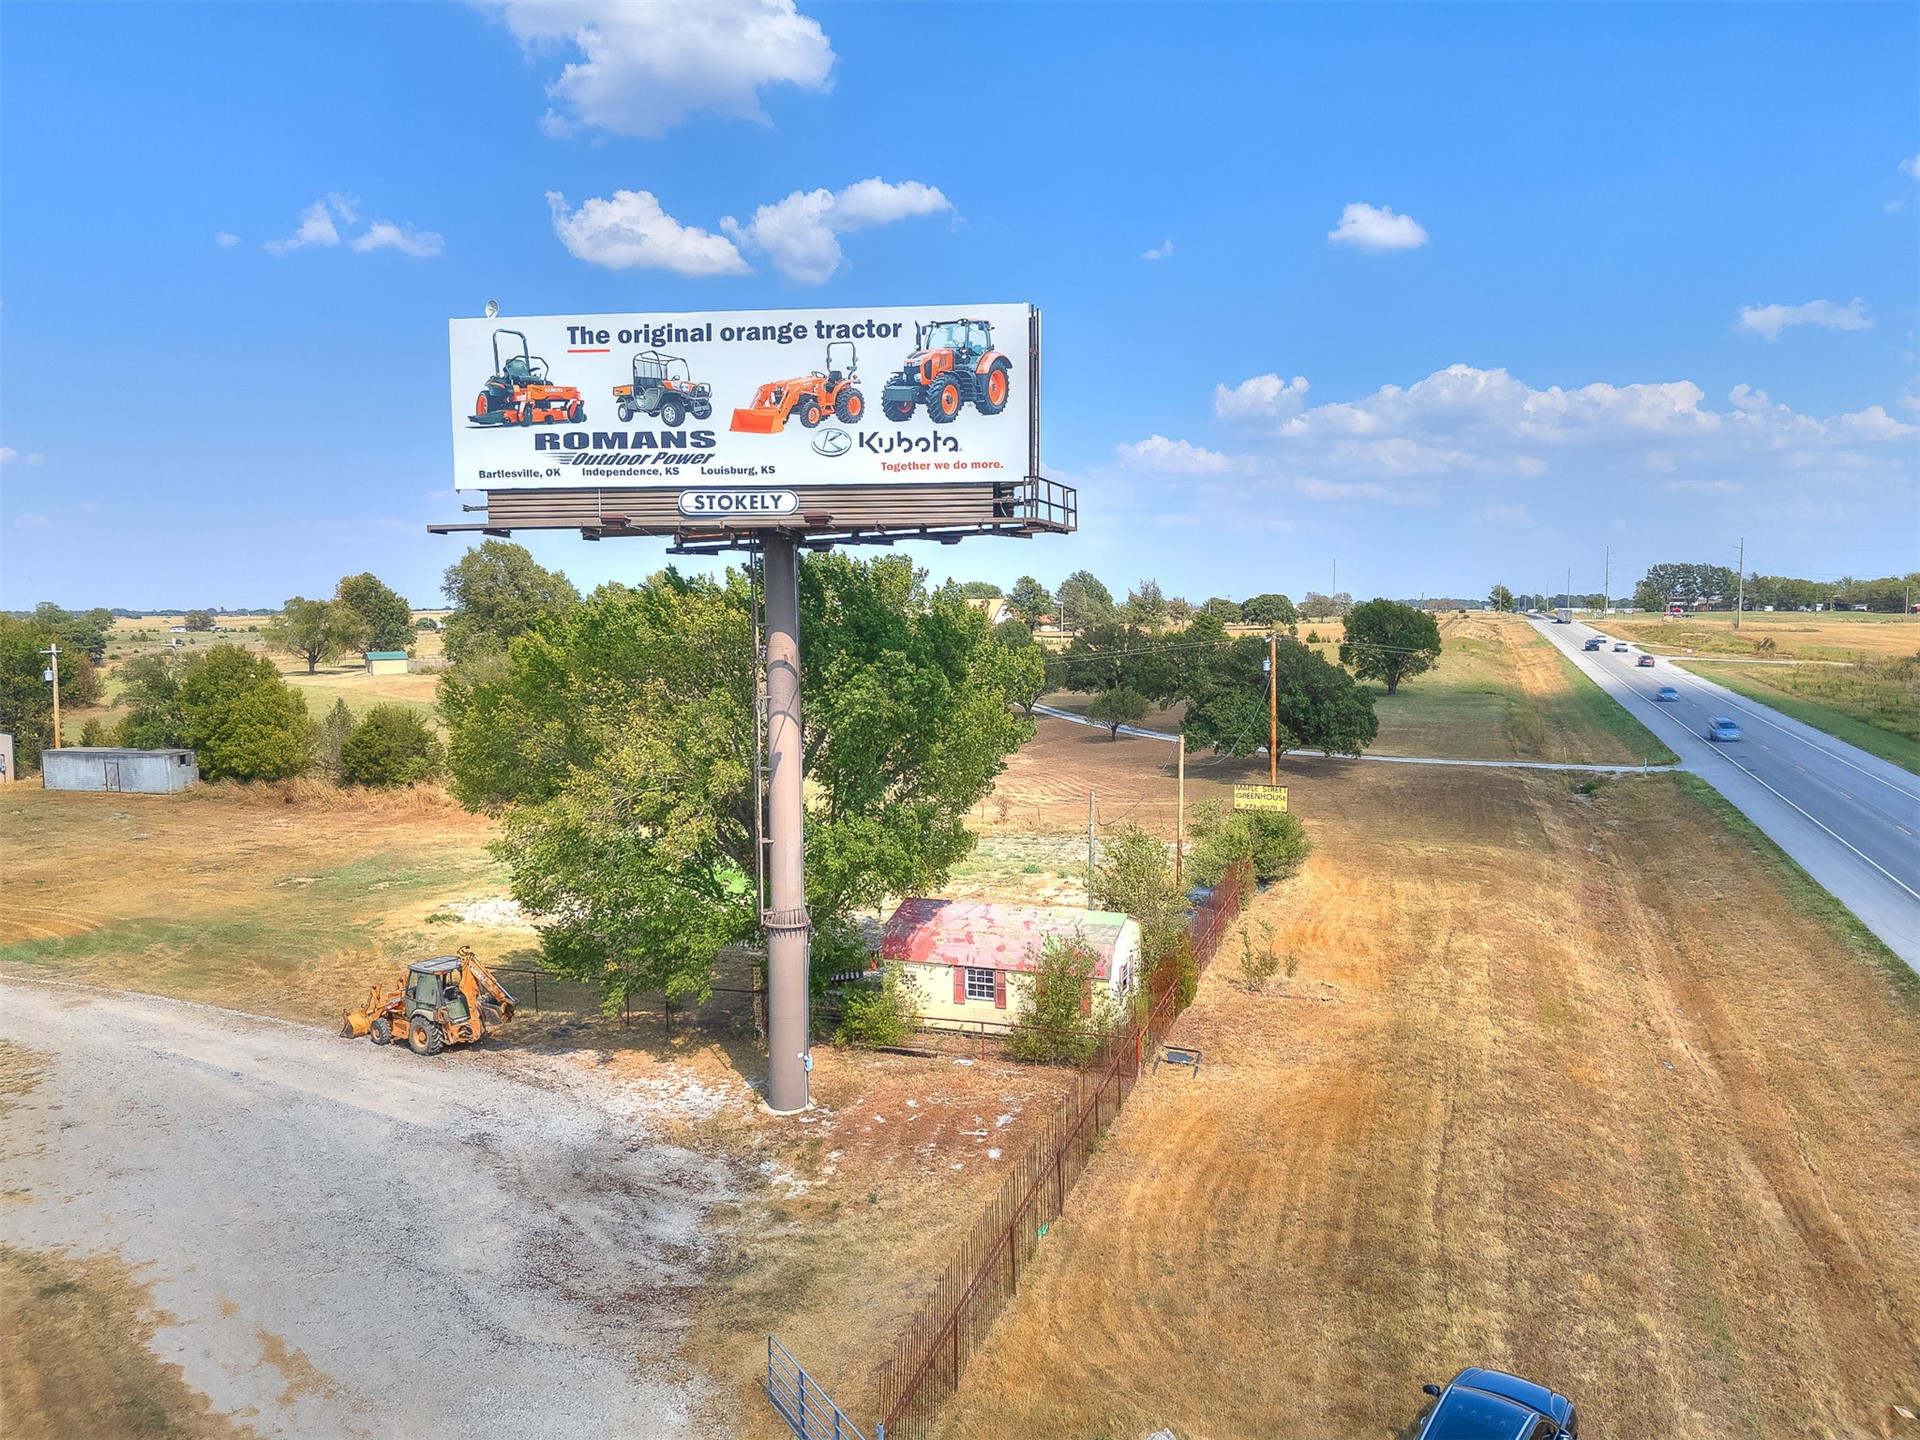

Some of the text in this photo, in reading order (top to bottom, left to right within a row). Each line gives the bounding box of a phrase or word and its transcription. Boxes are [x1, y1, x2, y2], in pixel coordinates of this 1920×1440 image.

[567, 319, 902, 348] The original orange tractor
[534, 430, 717, 451] ROMANS
[859, 430, 959, 454] Kubota
[572, 451, 716, 466] Outdoor Power
[880, 460, 1004, 472] Together we do more.
[478, 465, 776, 479] Bartlesville, OK Independence, KS Louisburg, KS
[694, 494, 783, 510] STOKELY
[1235, 792, 1287, 802] GREENHOUSE
